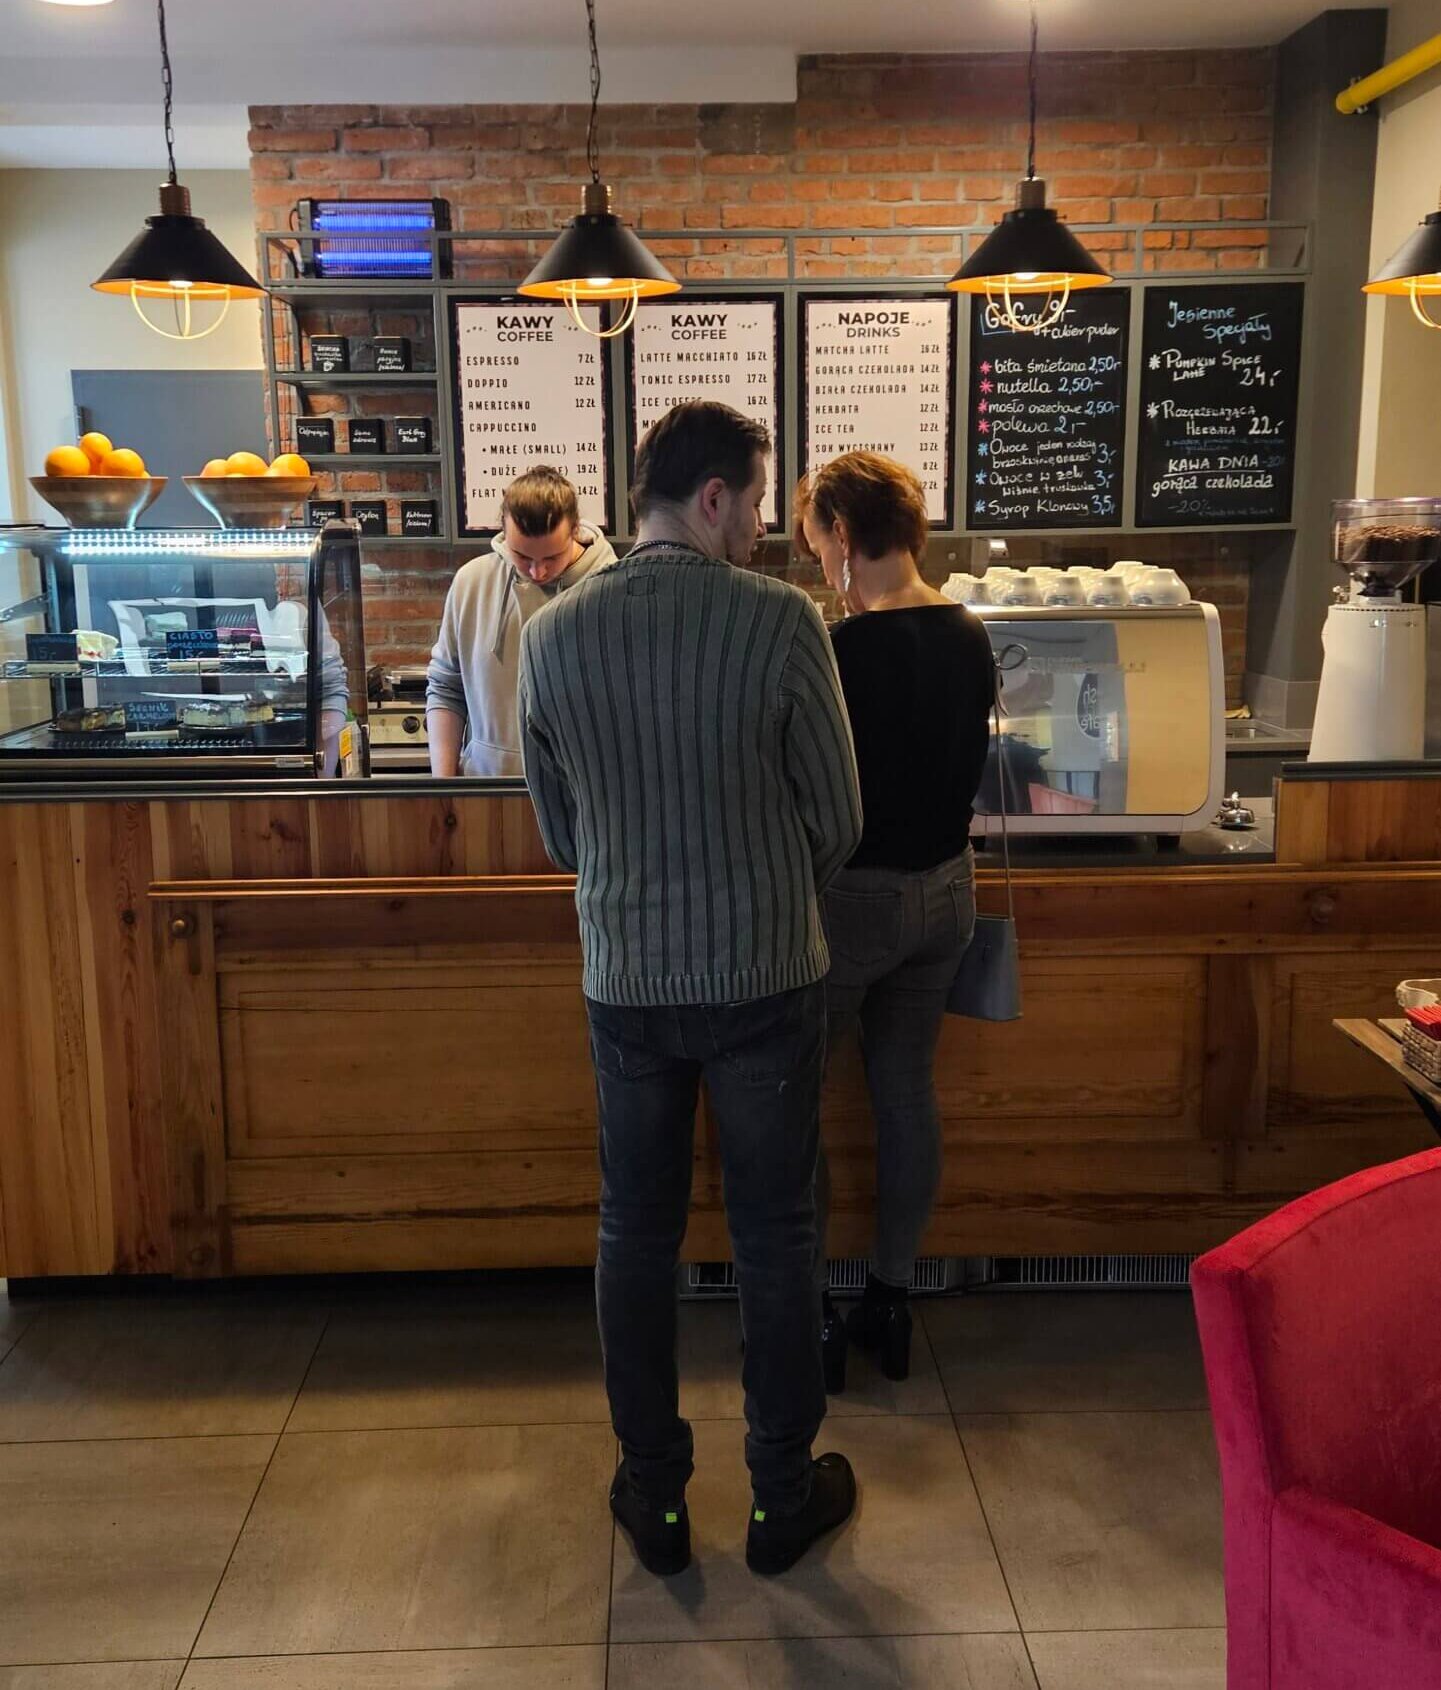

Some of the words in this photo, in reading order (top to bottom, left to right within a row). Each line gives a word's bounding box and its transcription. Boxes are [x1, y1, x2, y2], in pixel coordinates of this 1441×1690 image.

[671, 314, 728, 327] KAWY
[838, 312, 910, 325] NAPOJE
[1168, 300, 1236, 329] Jesienne
[497, 316, 554, 328] KAWY
[497, 331, 553, 342] COFFEE
[671, 329, 727, 340] COFFEE
[846, 327, 901, 338] DRINKS
[815, 346, 855, 355] MATCHA
[860, 345, 889, 355] LATTE
[466, 356, 519, 366] ESPRESSO
[640, 353, 671, 362] LATTE
[677, 352, 738, 362] MACCHIATO
[815, 366, 853, 375] GORĄCA
[859, 365, 915, 374] CZEKOLADA
[995, 358, 1023, 374] bita
[1027, 357, 1086, 373] śmietana
[467, 379, 508, 388] DOPPIO
[574, 376, 584, 386] 12
[641, 375, 673, 384] TONIC
[678, 374, 730, 384] ESPRESSO
[815, 385, 846, 395] BIAŁA
[851, 384, 907, 394] CZEKOLADA
[997, 377, 1052, 394] nutella
[468, 401, 530, 410] AMERICANO
[575, 398, 584, 408] 12
[641, 397, 659, 407] ICE
[664, 397, 702, 407] COF
[988, 399, 1025, 414] masło
[815, 405, 859, 414] HERBATA
[469, 423, 537, 432] CAPPUCCINO
[815, 424, 832, 434] ICE
[837, 424, 855, 433] TEA
[992, 415, 1050, 438] polewa
[490, 445, 518, 455] MAŁE
[523, 444, 567, 455] (SMALL)
[576, 442, 585, 452] 14
[815, 444, 833, 453] SOK
[990, 438, 1029, 455] Owoce
[1168, 458, 1211, 473] KAWA
[1217, 454, 1259, 469] DNIA
[491, 464, 517, 476] DUŻE
[1151, 475, 1199, 498] gorąca
[1205, 474, 1274, 489] czekolada
[472, 488, 496, 498] FLAT
[988, 499, 1029, 519] Syrop
